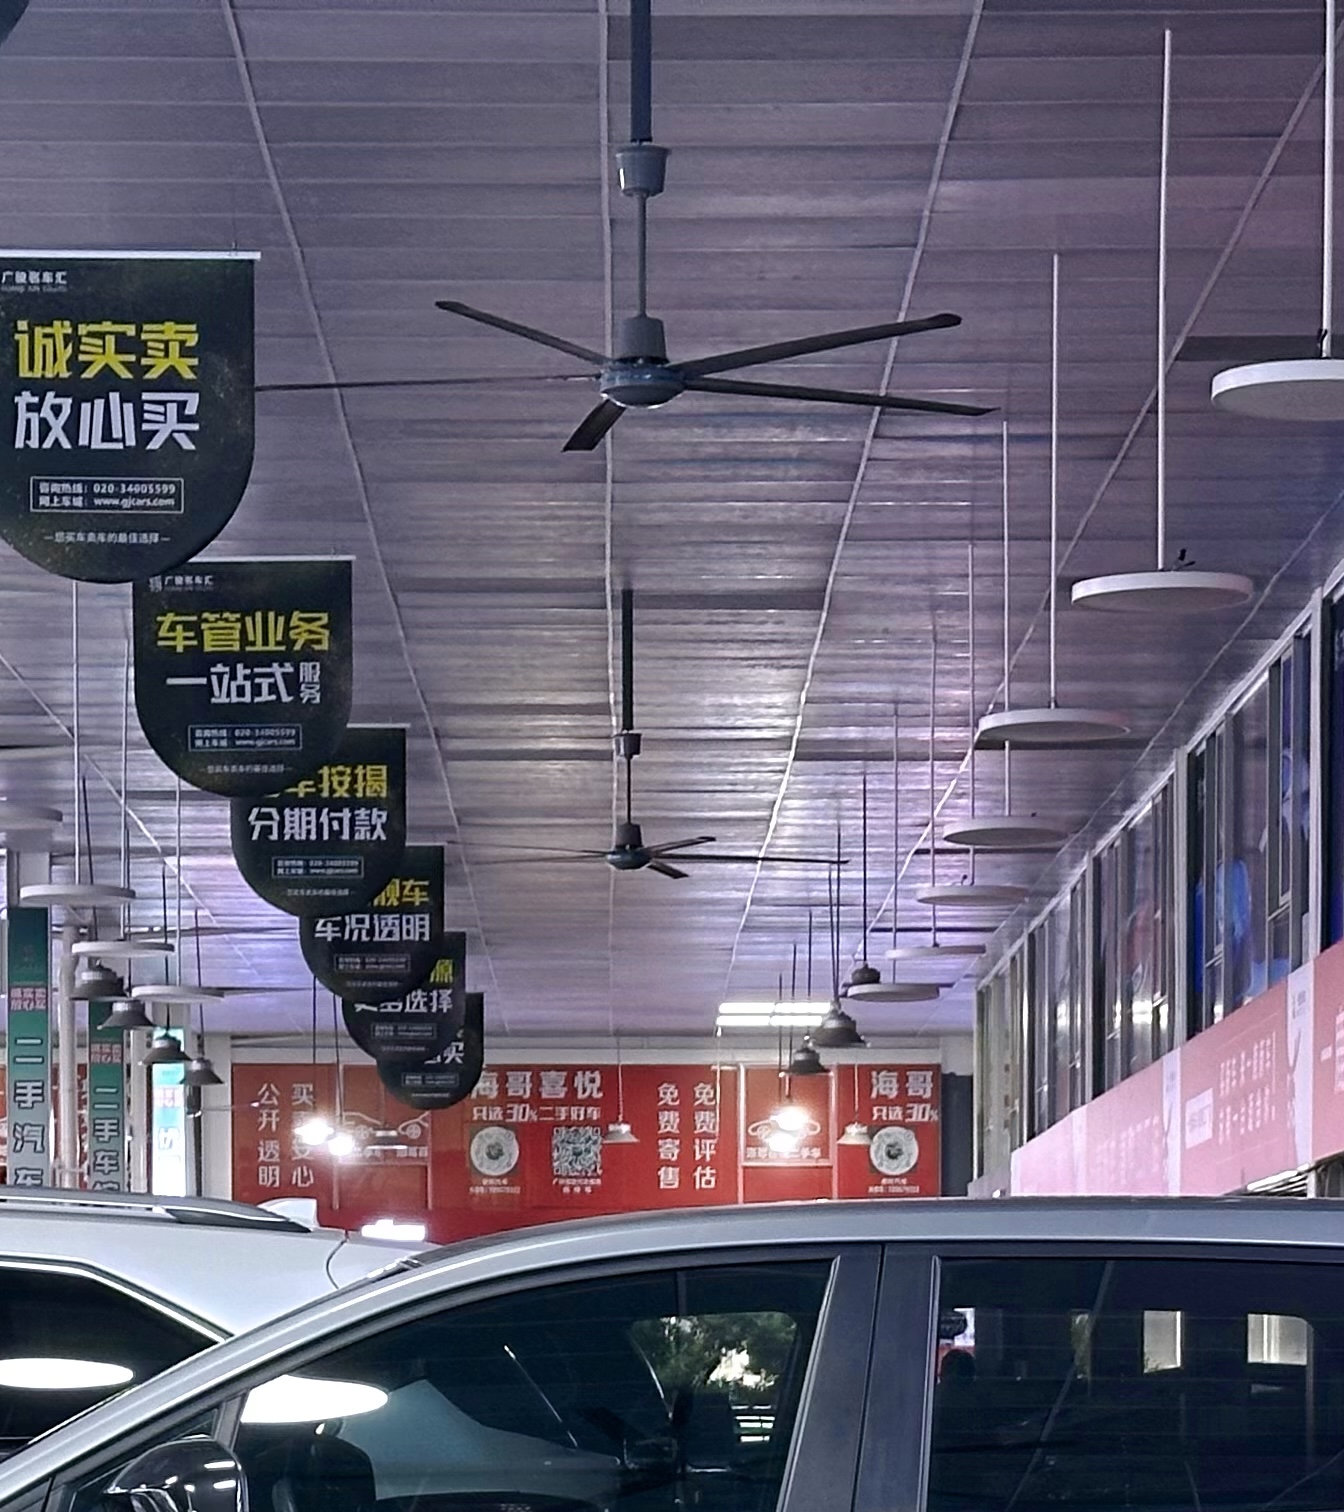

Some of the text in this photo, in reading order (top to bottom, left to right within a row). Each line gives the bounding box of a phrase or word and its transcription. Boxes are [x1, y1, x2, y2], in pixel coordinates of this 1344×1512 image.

[14, 320, 200, 380] 诚实卖
[14, 391, 200, 450] 放心买
[93, 496, 176, 508] www.gjcars.com
[156, 610, 331, 653] 车管业务
[166, 661, 322, 704] 一站式 服务
[248, 807, 388, 841] 分期付款
[314, 913, 431, 942] 车况透明
[470, 1071, 604, 1099] 海哥喜悦
[871, 1070, 934, 1098] 海哥
[257, 1083, 280, 1187] 公开透明
[657, 1082, 680, 1189] 免费寄售
[693, 1082, 717, 1190] 免费评估
